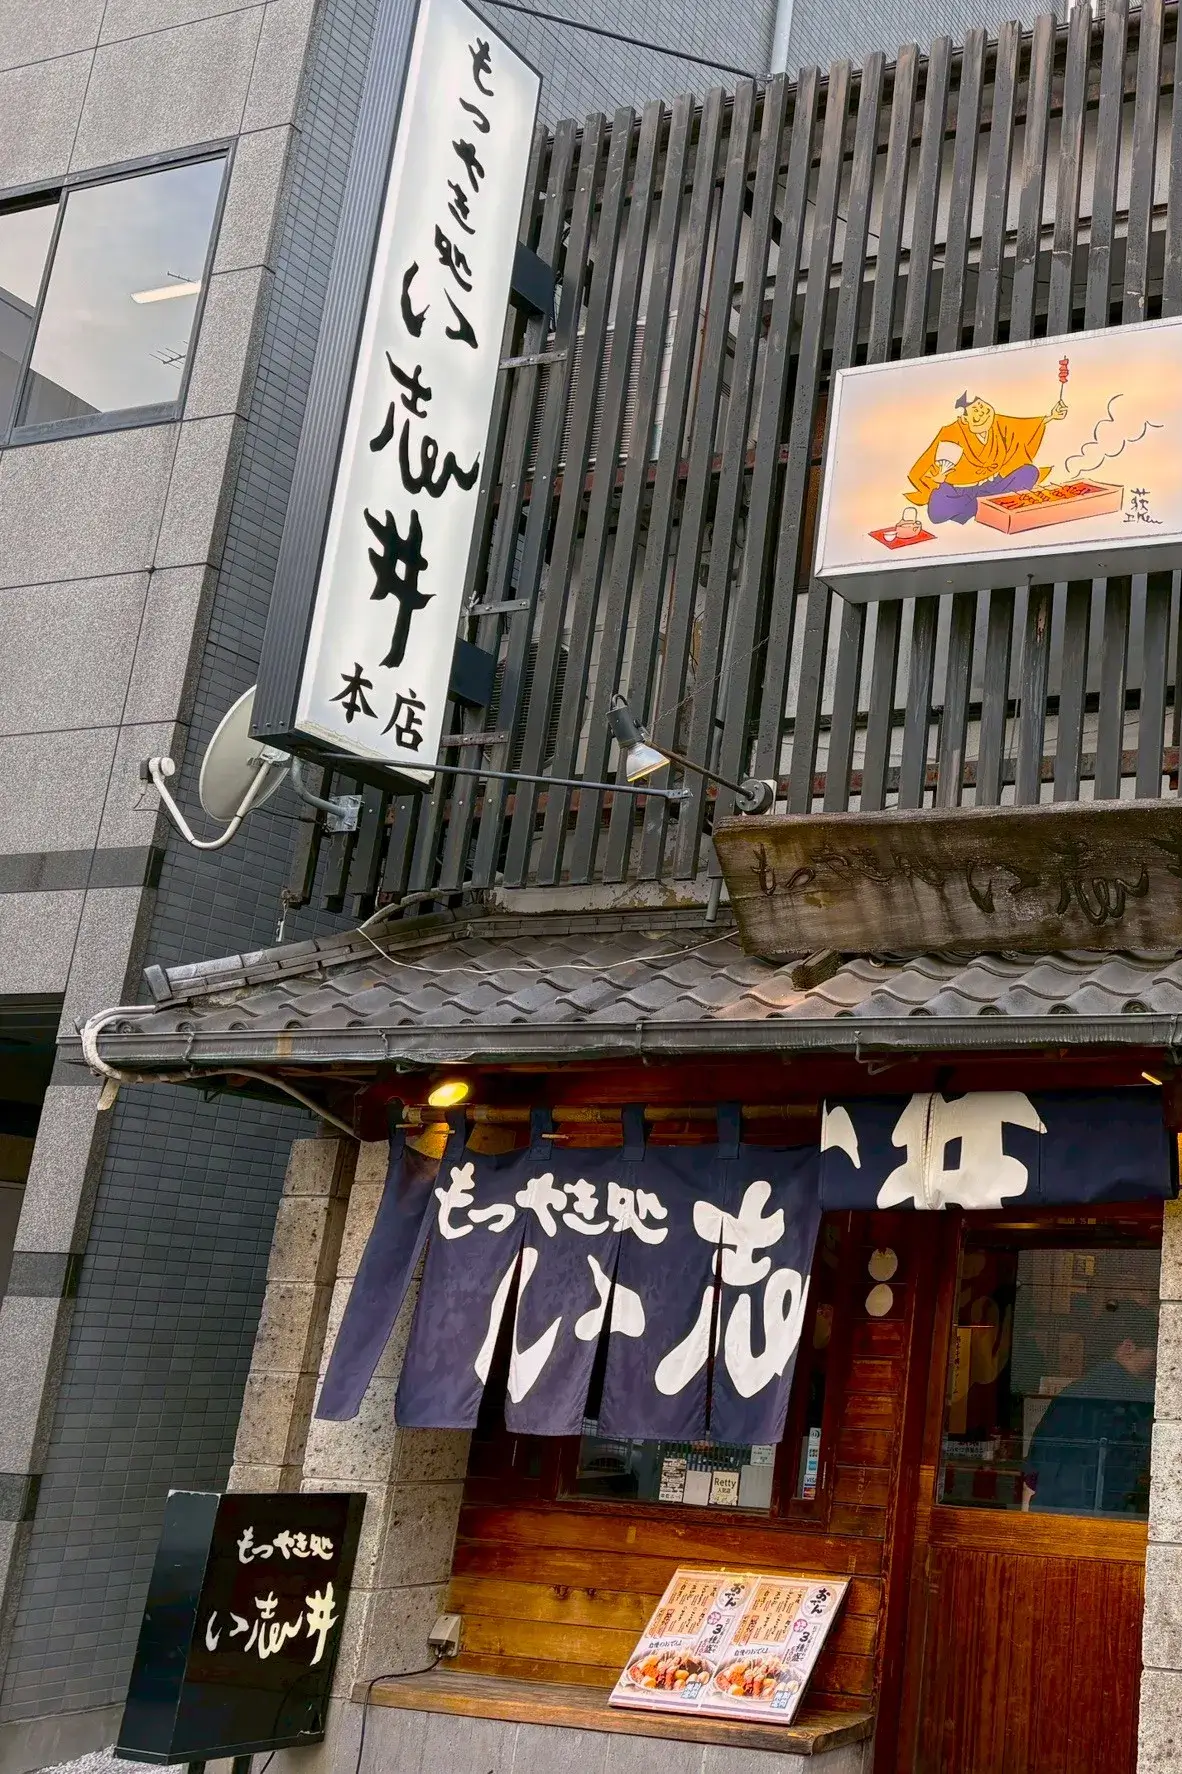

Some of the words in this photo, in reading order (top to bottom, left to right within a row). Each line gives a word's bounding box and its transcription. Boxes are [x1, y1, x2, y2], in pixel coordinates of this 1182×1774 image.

[329, 662, 424, 753] 本店
[435, 1161, 669, 1245] もつやき処
[714, 1477, 737, 1489] Retty
[236, 1525, 334, 1564] もつやき処
